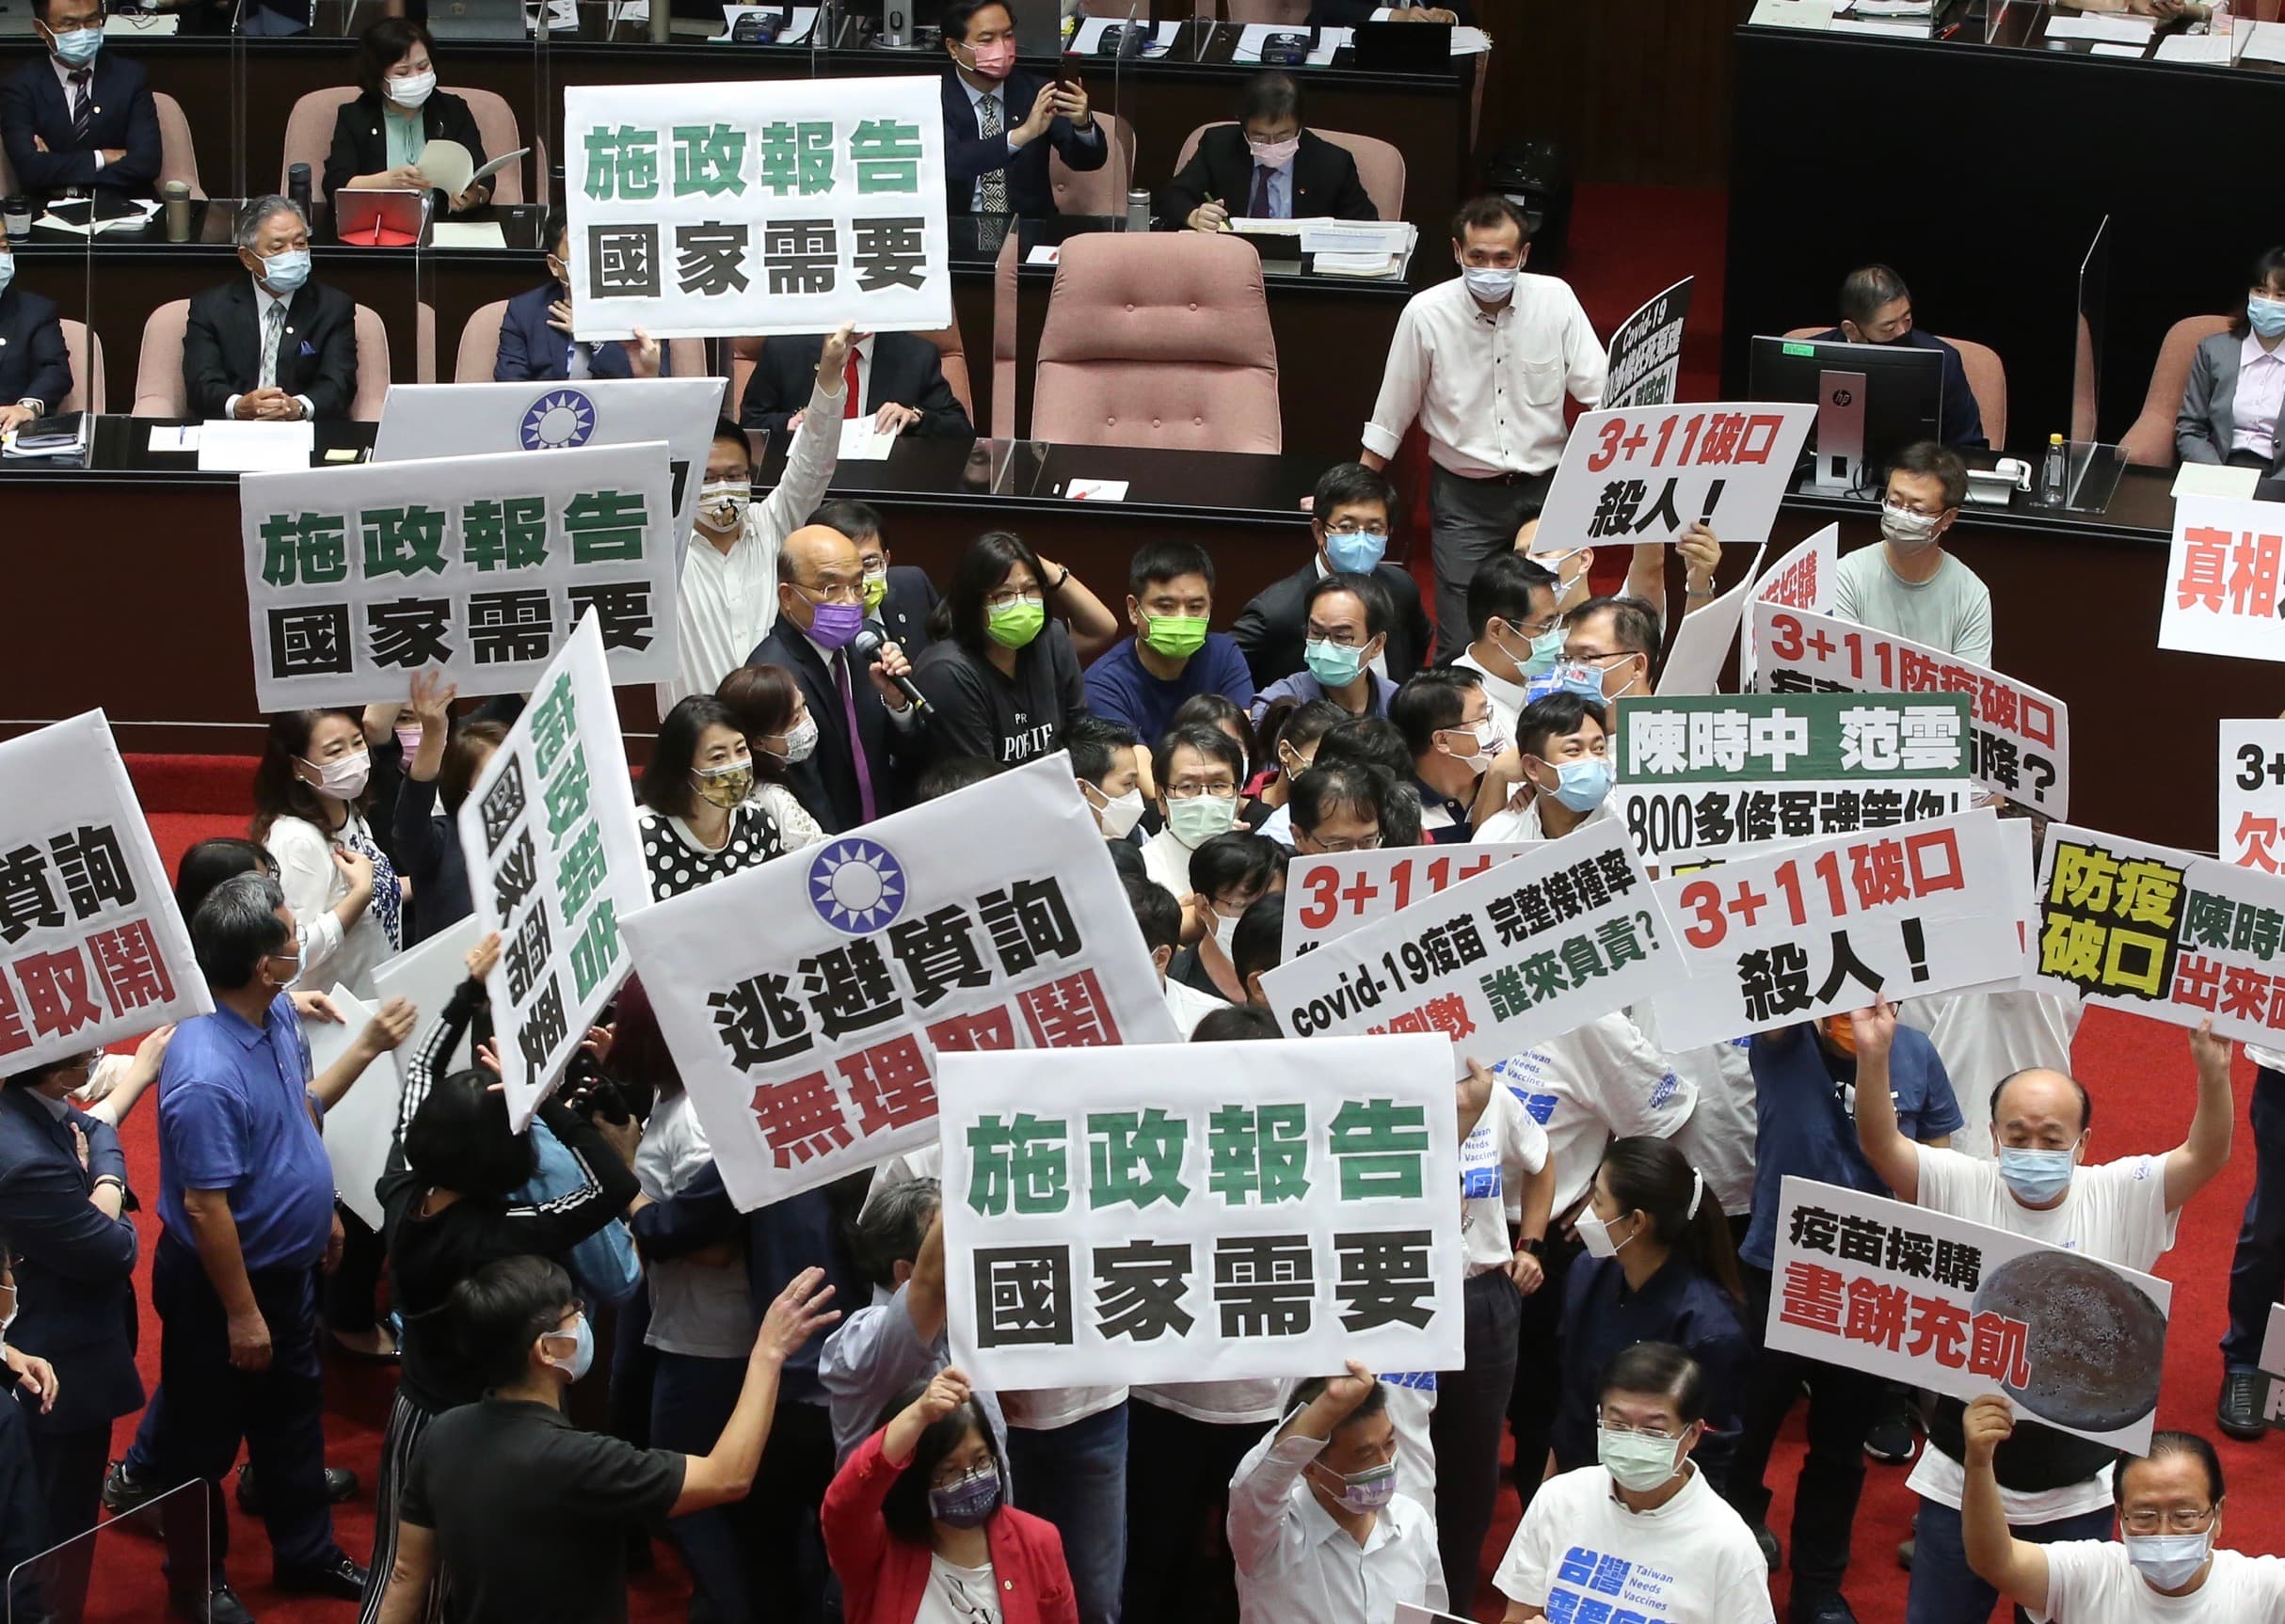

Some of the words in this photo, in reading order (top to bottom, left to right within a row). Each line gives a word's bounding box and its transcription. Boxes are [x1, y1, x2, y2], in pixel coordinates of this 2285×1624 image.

[583, 119, 923, 201] 施政報告
[587, 216, 927, 299] 國家需要
[1834, 390, 1850, 406] hp
[1588, 412, 1784, 472] 3+11破口
[260, 490, 649, 587] 施政報告
[1587, 477, 1726, 537] 殺人!
[2178, 527, 2285, 619] 真相
[267, 581, 654, 679] 國家需要
[1627, 708, 1809, 776] 陳時中
[1839, 705, 1962, 772] 范雲
[531, 670, 618, 1007] 施政報告
[2234, 811, 2285, 876] 欠
[0, 825, 137, 944] 質詢
[480, 751, 568, 1085] 國家需要
[1679, 828, 1965, 949] 3+11破口
[2049, 843, 2182, 930] 防疫
[2182, 889, 2285, 961] 陳時
[707, 876, 1083, 1073] 逃避質詢
[1291, 913, 1487, 1038] covid-19疫苗
[1486, 847, 1637, 947] 完整接種率
[1478, 910, 1660, 1023] 誰來負責?
[1736, 917, 1929, 1023] 殺人!
[2041, 912, 2168, 997] 破口
[1511, 1058, 1541, 1074] Needs
[1520, 1050, 1551, 1064] aiwan
[967, 1098, 1430, 1217] 施政報告
[973, 1230, 1436, 1348] 國家需要
[1788, 1204, 1982, 1293] 疫苗採購
[1780, 1260, 2032, 1390] 畫餅充飢
[1558, 1546, 1632, 1597] 台灣
[1623, 1590, 1668, 1611] Vaccines
[1629, 1577, 1662, 1594] Needs
[1636, 1564, 1673, 1584] Taiwan
